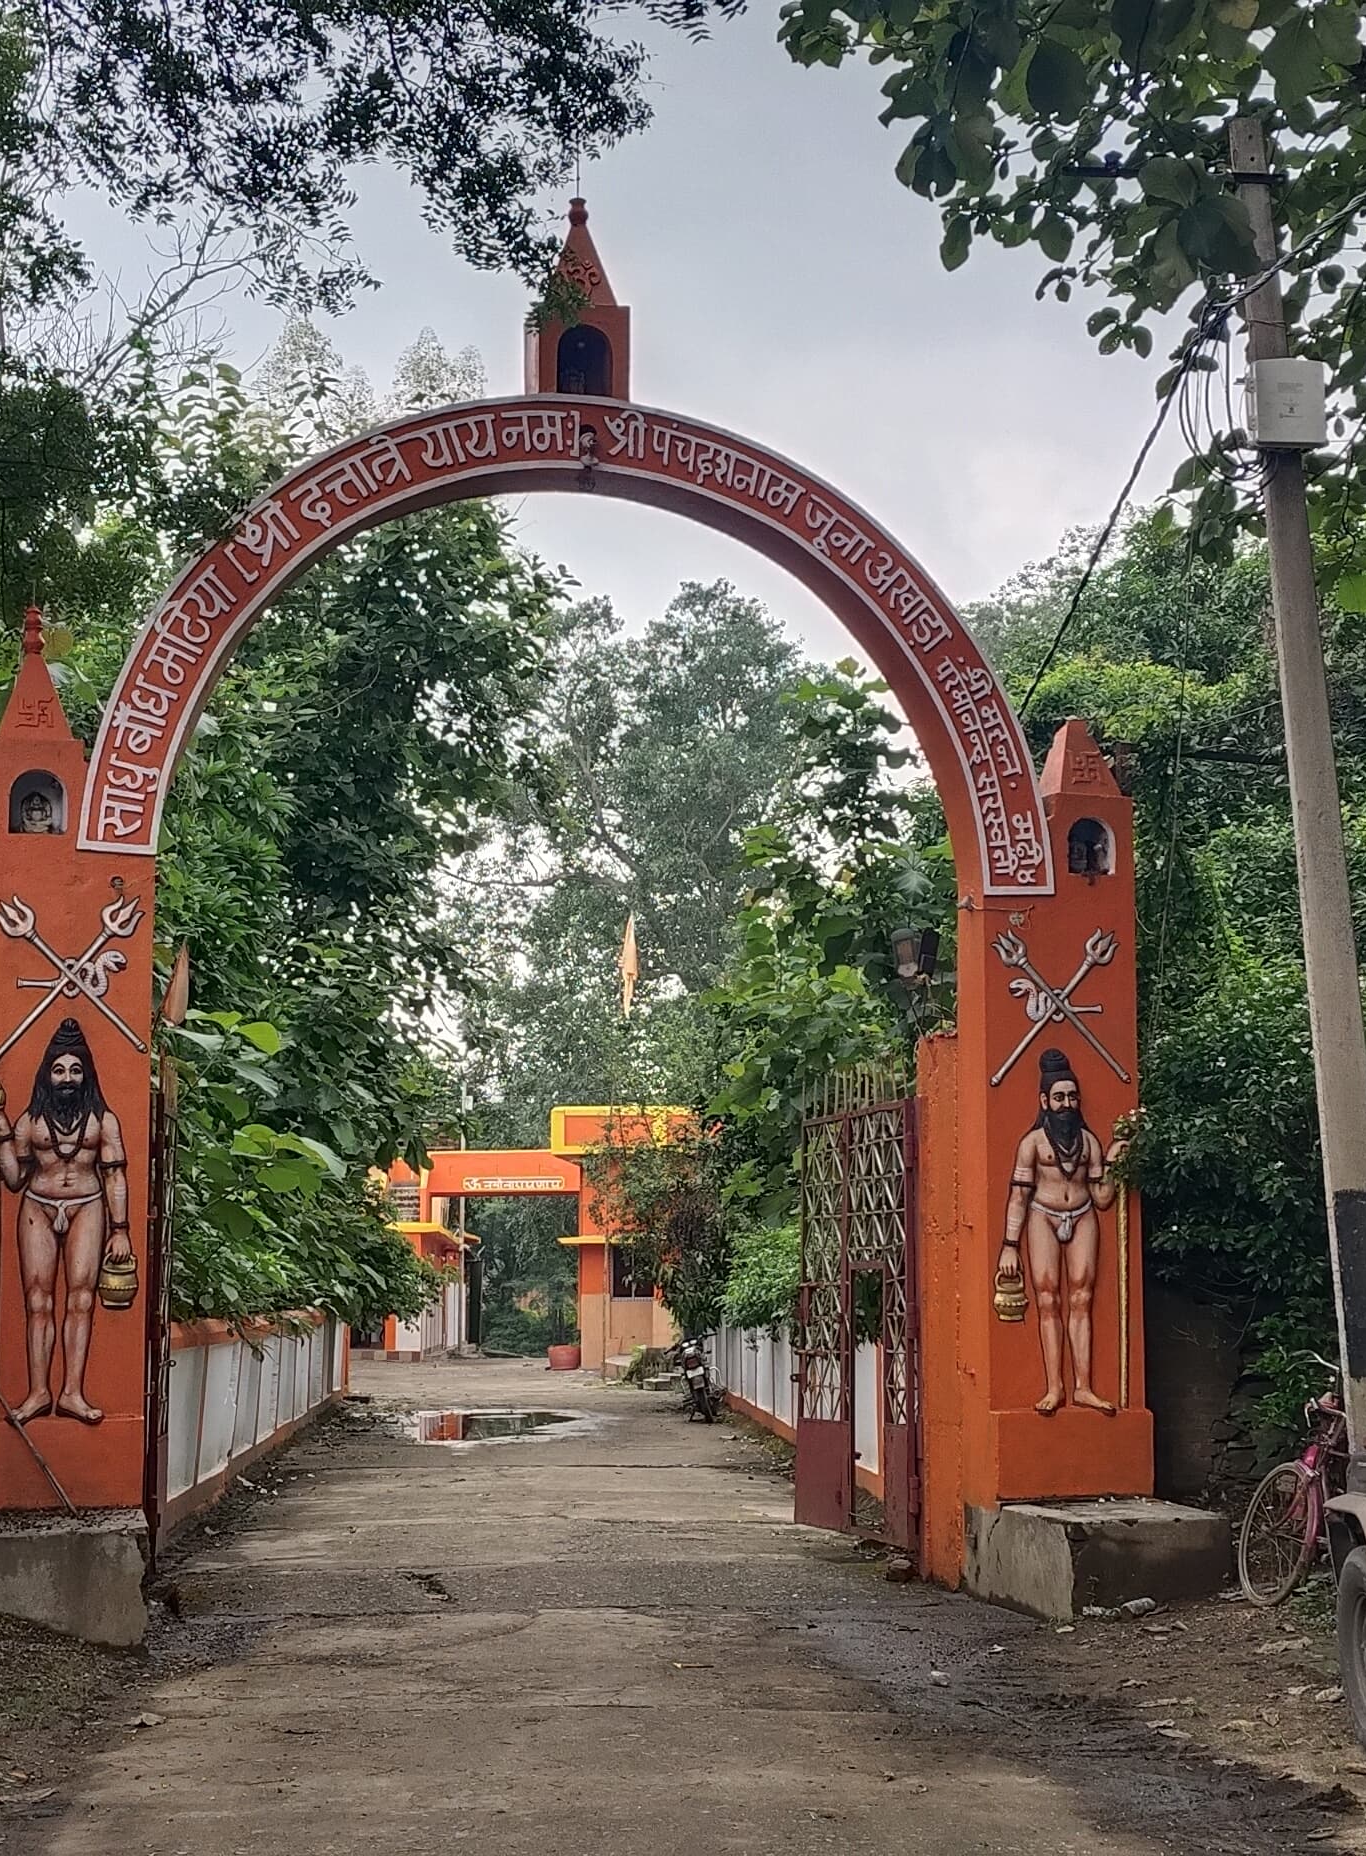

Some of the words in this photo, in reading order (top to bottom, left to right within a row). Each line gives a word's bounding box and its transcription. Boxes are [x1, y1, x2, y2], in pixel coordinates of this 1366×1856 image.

[98, 753, 160, 841] साधु
[604, 410, 647, 459] श्री
[653, 423, 806, 515] पंचदशनाम
[805, 493, 876, 565] जूना
[865, 551, 953, 653] अखाड़ा
[962, 665, 993, 701] श्री
[978, 771, 1019, 877] सरस्वती
